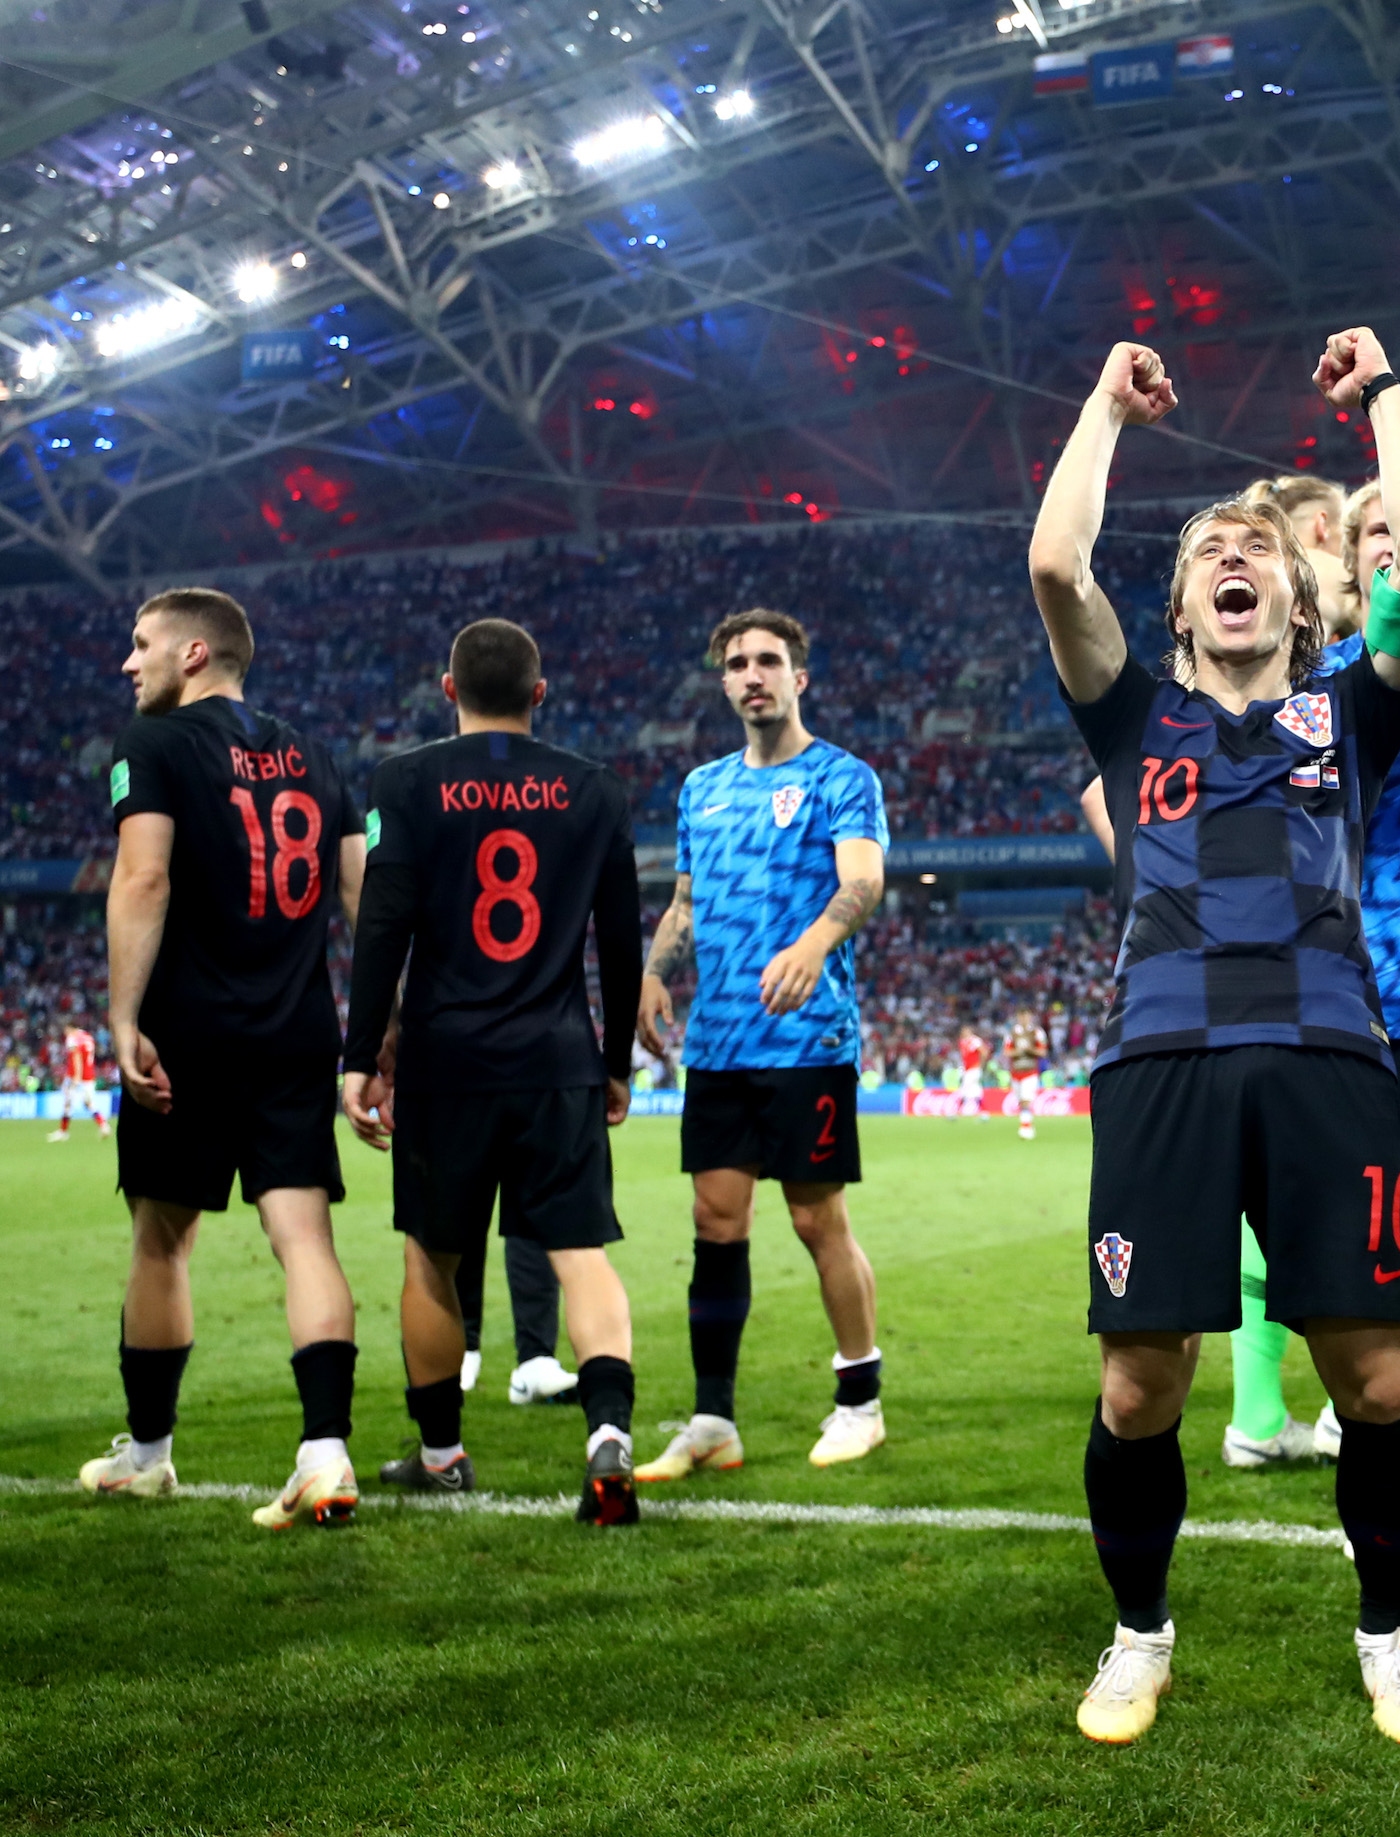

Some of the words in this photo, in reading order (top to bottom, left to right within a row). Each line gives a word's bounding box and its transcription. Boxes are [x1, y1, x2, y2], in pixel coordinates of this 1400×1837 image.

[1103, 61, 1160, 88] FIFA
[251, 344, 303, 367] FIFA
[230, 744, 307, 781] REBIĆ
[440, 774, 570, 813] KOVAČIĆ
[1138, 757, 1199, 825] 10
[229, 785, 323, 920] 18
[472, 828, 541, 963] 8
[816, 1094, 837, 1147] 2
